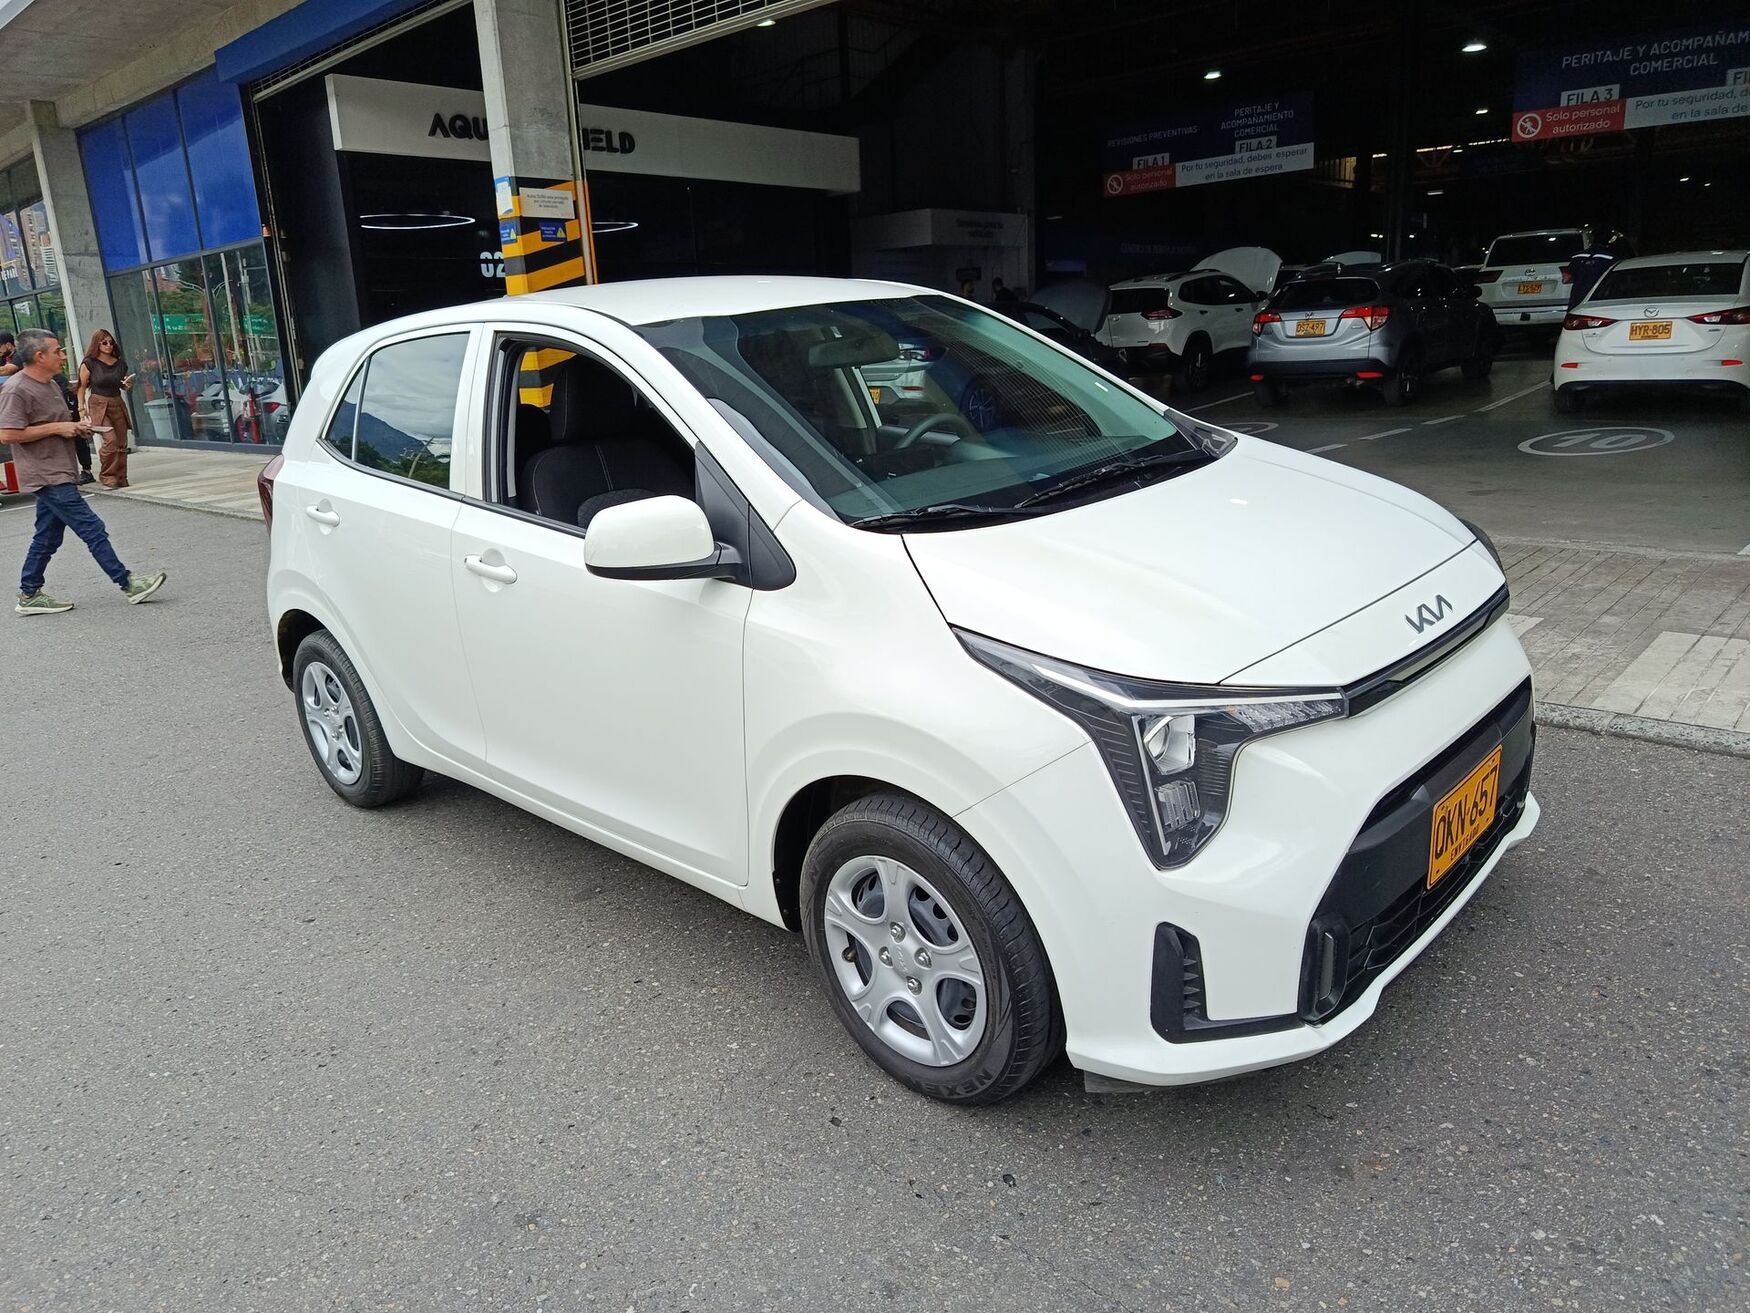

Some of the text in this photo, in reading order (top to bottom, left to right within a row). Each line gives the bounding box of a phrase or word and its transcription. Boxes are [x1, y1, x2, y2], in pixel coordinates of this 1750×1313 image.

[1562, 46, 1633, 69] PERITAJE
[1636, 44, 1648, 57] Y
[1630, 52, 1719, 76] COMERCIAL
[1567, 88, 1614, 107] FILA 3
[1635, 100, 1656, 111] Por
[1657, 98, 1669, 107] tu
[1672, 88, 1737, 106] seguridad,
[1234, 101, 1281, 117] PERITAJE Y
[1546, 104, 1621, 122] Solo personal
[1671, 103, 1748, 120] en la sala de
[1234, 124, 1279, 138] COMERCIAL
[1552, 118, 1611, 134] autorizado
[1239, 138, 1273, 153] FILA 2
[1137, 157, 1160, 168] FILA
[1181, 163, 1194, 173] Por
[1195, 161, 1203, 170] tu
[1247, 153, 1273, 164] debes
[1276, 148, 1308, 161] esperar
[1205, 163, 1283, 180] en la sala de espera
[1551, 433, 1648, 449] 10
[1405, 594, 1453, 634] KIA
